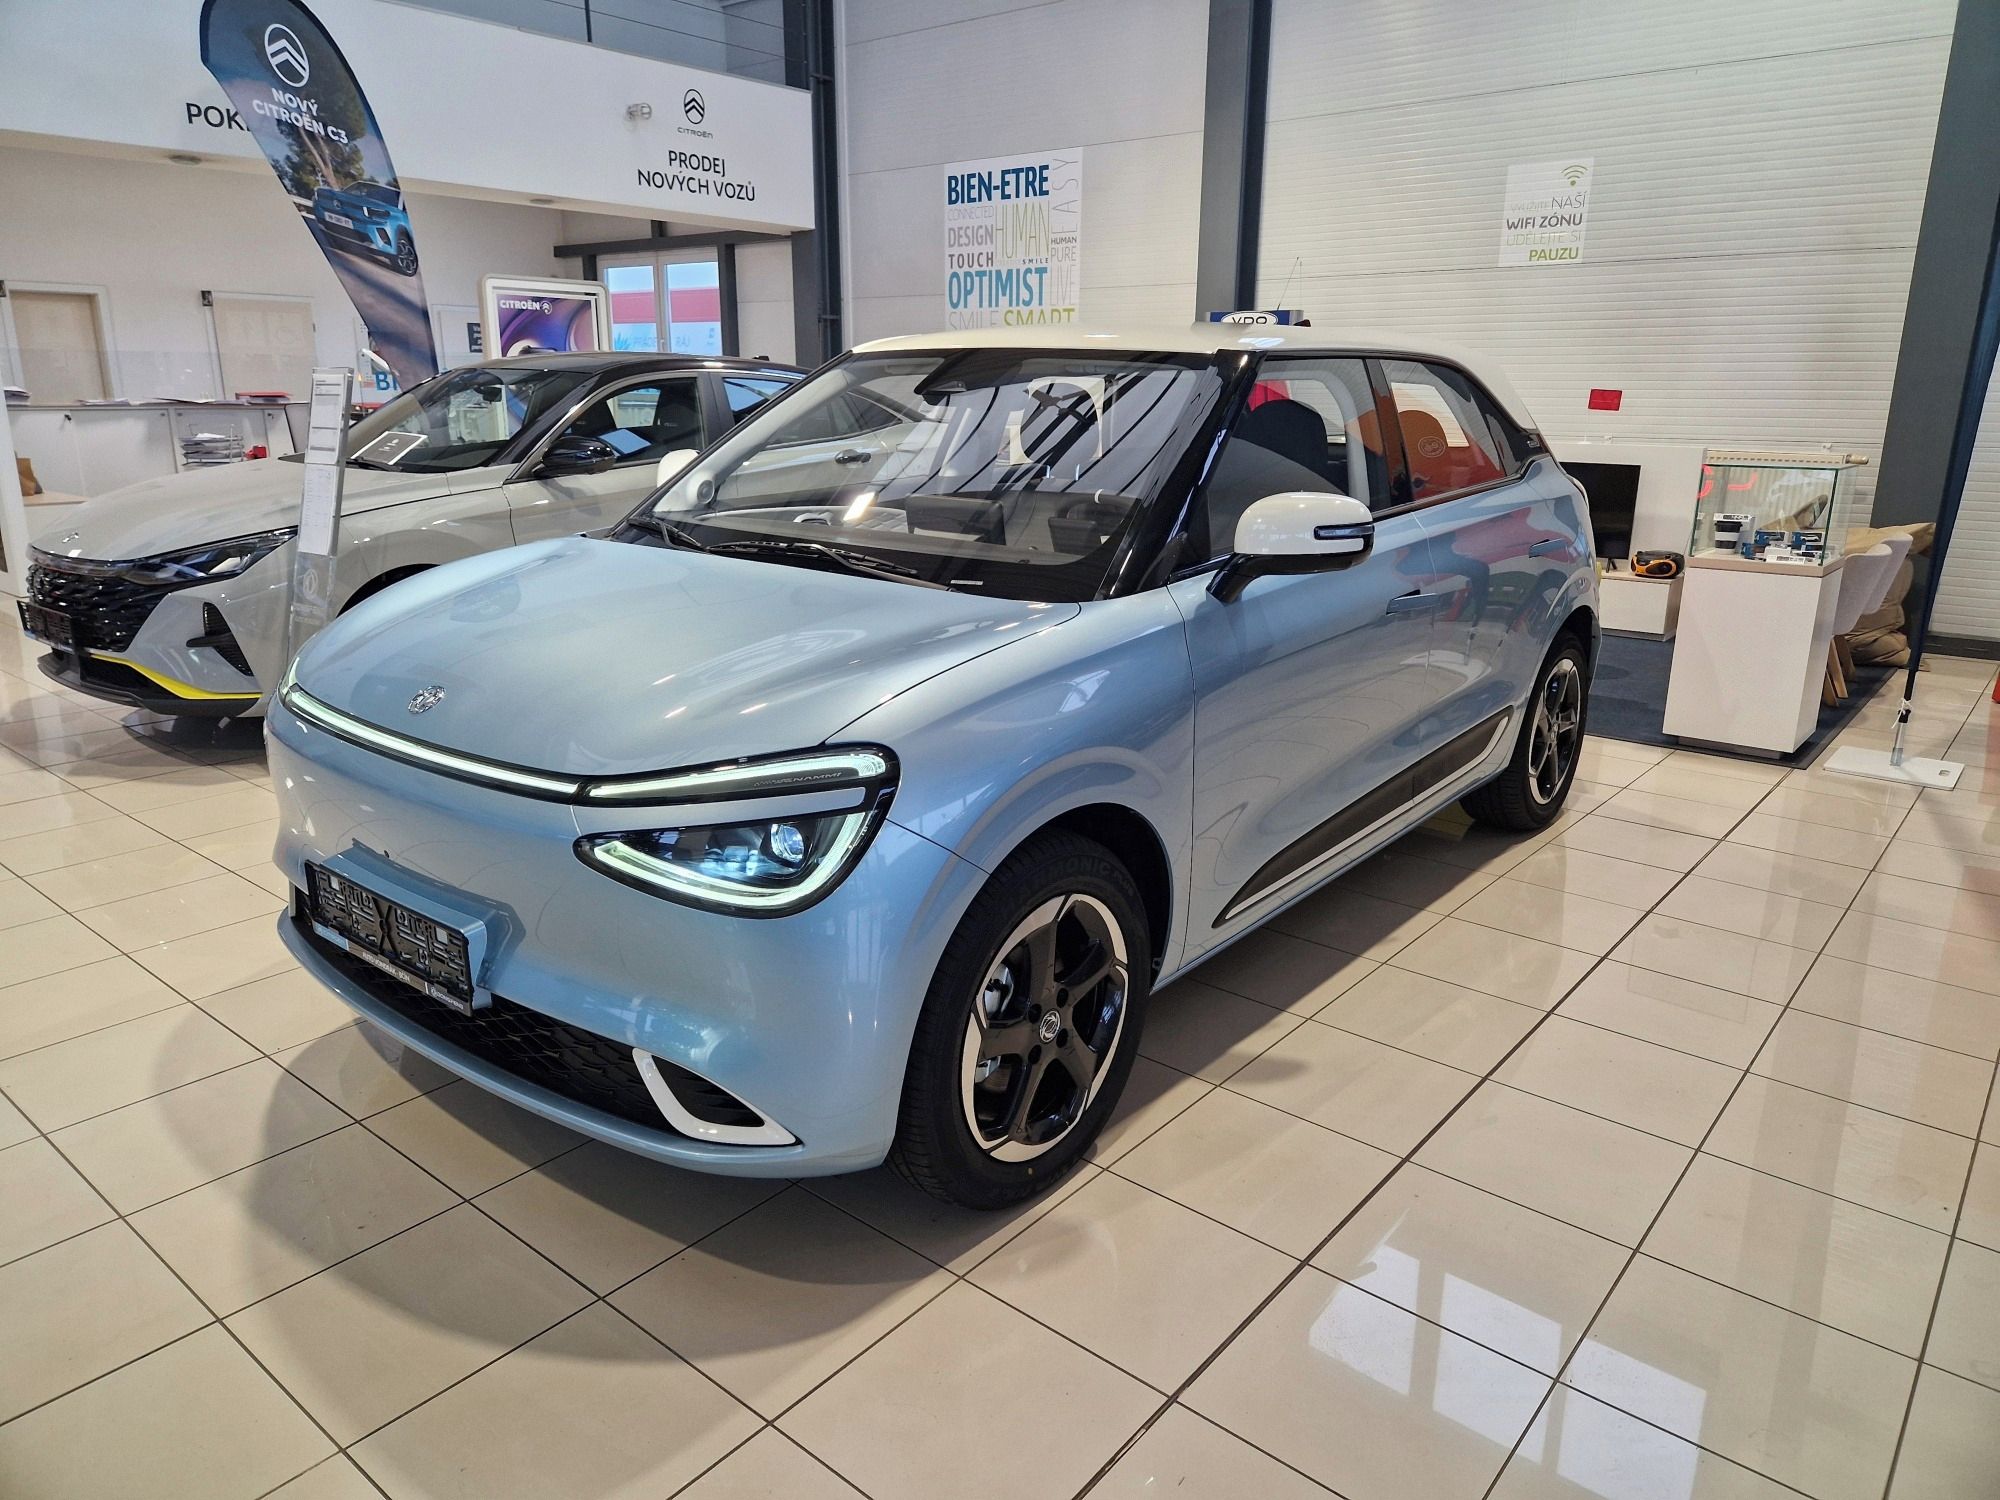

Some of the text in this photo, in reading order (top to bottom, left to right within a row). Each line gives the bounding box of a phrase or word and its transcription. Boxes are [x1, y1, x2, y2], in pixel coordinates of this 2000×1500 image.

[272, 88, 318, 117] NOVÝ
[186, 102, 251, 133] POK
[252, 99, 348, 145] CITROËN C3
[677, 126, 714, 140] CITROËN
[668, 150, 726, 178] PRODEJ
[637, 168, 756, 202] NOVÝCH VOZŮ
[947, 164, 1050, 206] BIEN-ETRE
[1551, 190, 1587, 210] NAŠÍ
[995, 199, 1050, 260] HUMAN
[1506, 211, 1583, 230] WIFI ZÓNU
[948, 224, 994, 249] DESIGN
[1051, 235, 1077, 245] HUMAN
[948, 251, 994, 269] TOUCH
[1022, 257, 1049, 265] SMILE
[1051, 245, 1077, 263] PURE
[1528, 246, 1580, 262] PAUZU
[948, 267, 1048, 310] OPTIMIST
[500, 299, 541, 310] CITROËN
